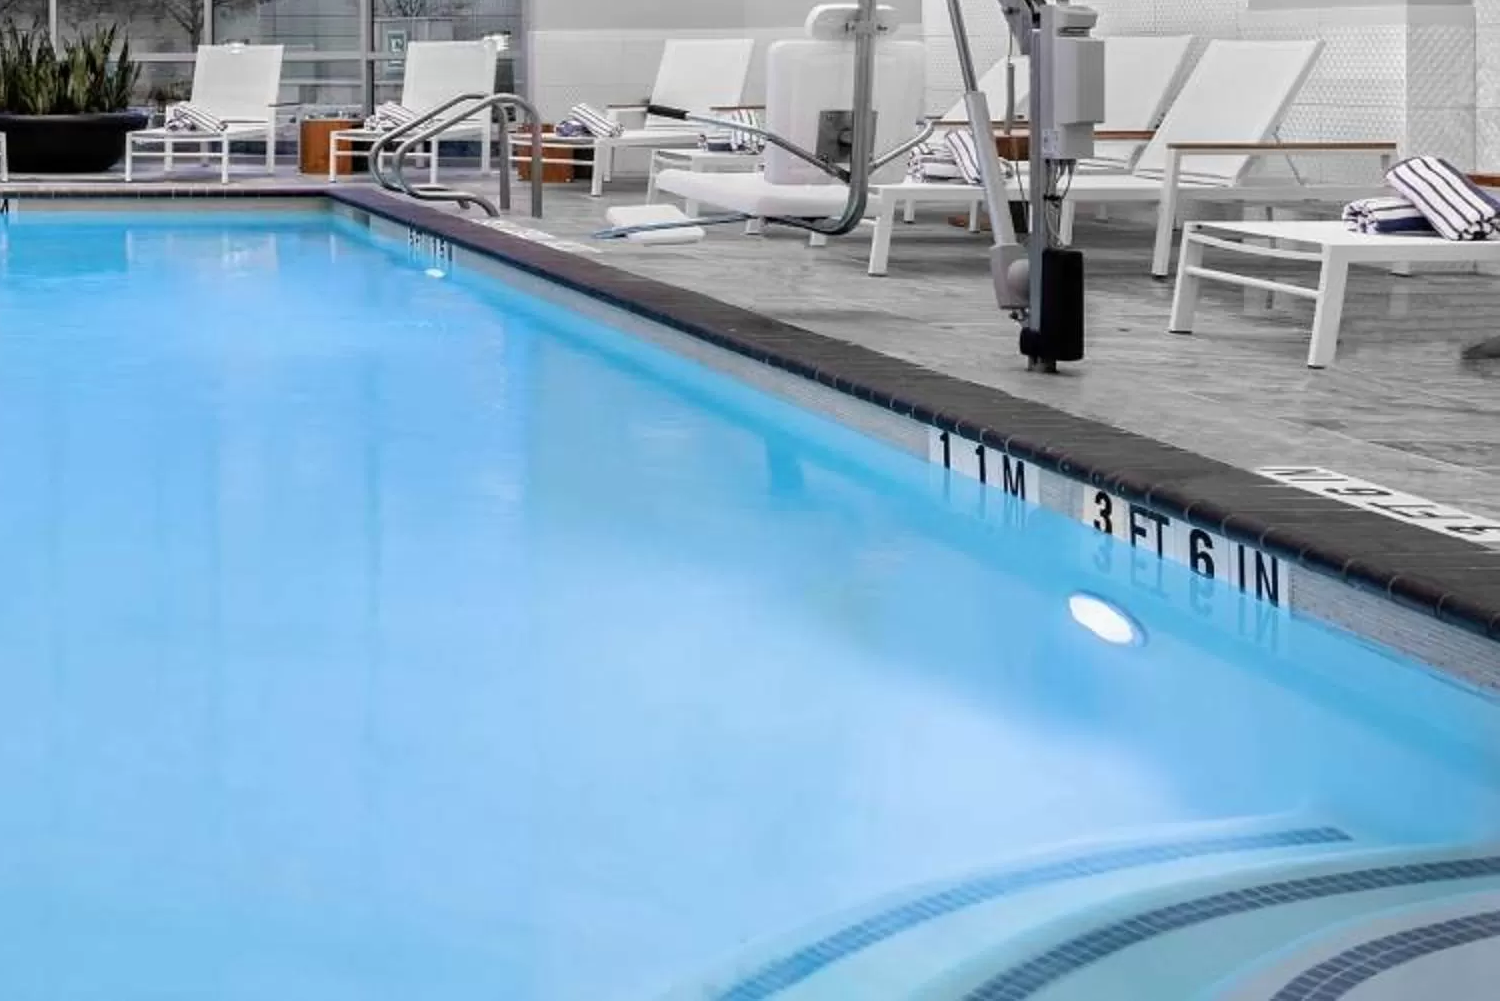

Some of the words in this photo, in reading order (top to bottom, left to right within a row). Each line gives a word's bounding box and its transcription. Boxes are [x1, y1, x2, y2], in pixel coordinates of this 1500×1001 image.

[940, 431, 949, 469] 1
[976, 445, 986, 484] 1
[1003, 455, 1025, 500] M
[1094, 492, 1112, 535] 3
[1130, 503, 1170, 559] FT
[1190, 529, 1214, 579] 6
[1238, 545, 1279, 608] IN
